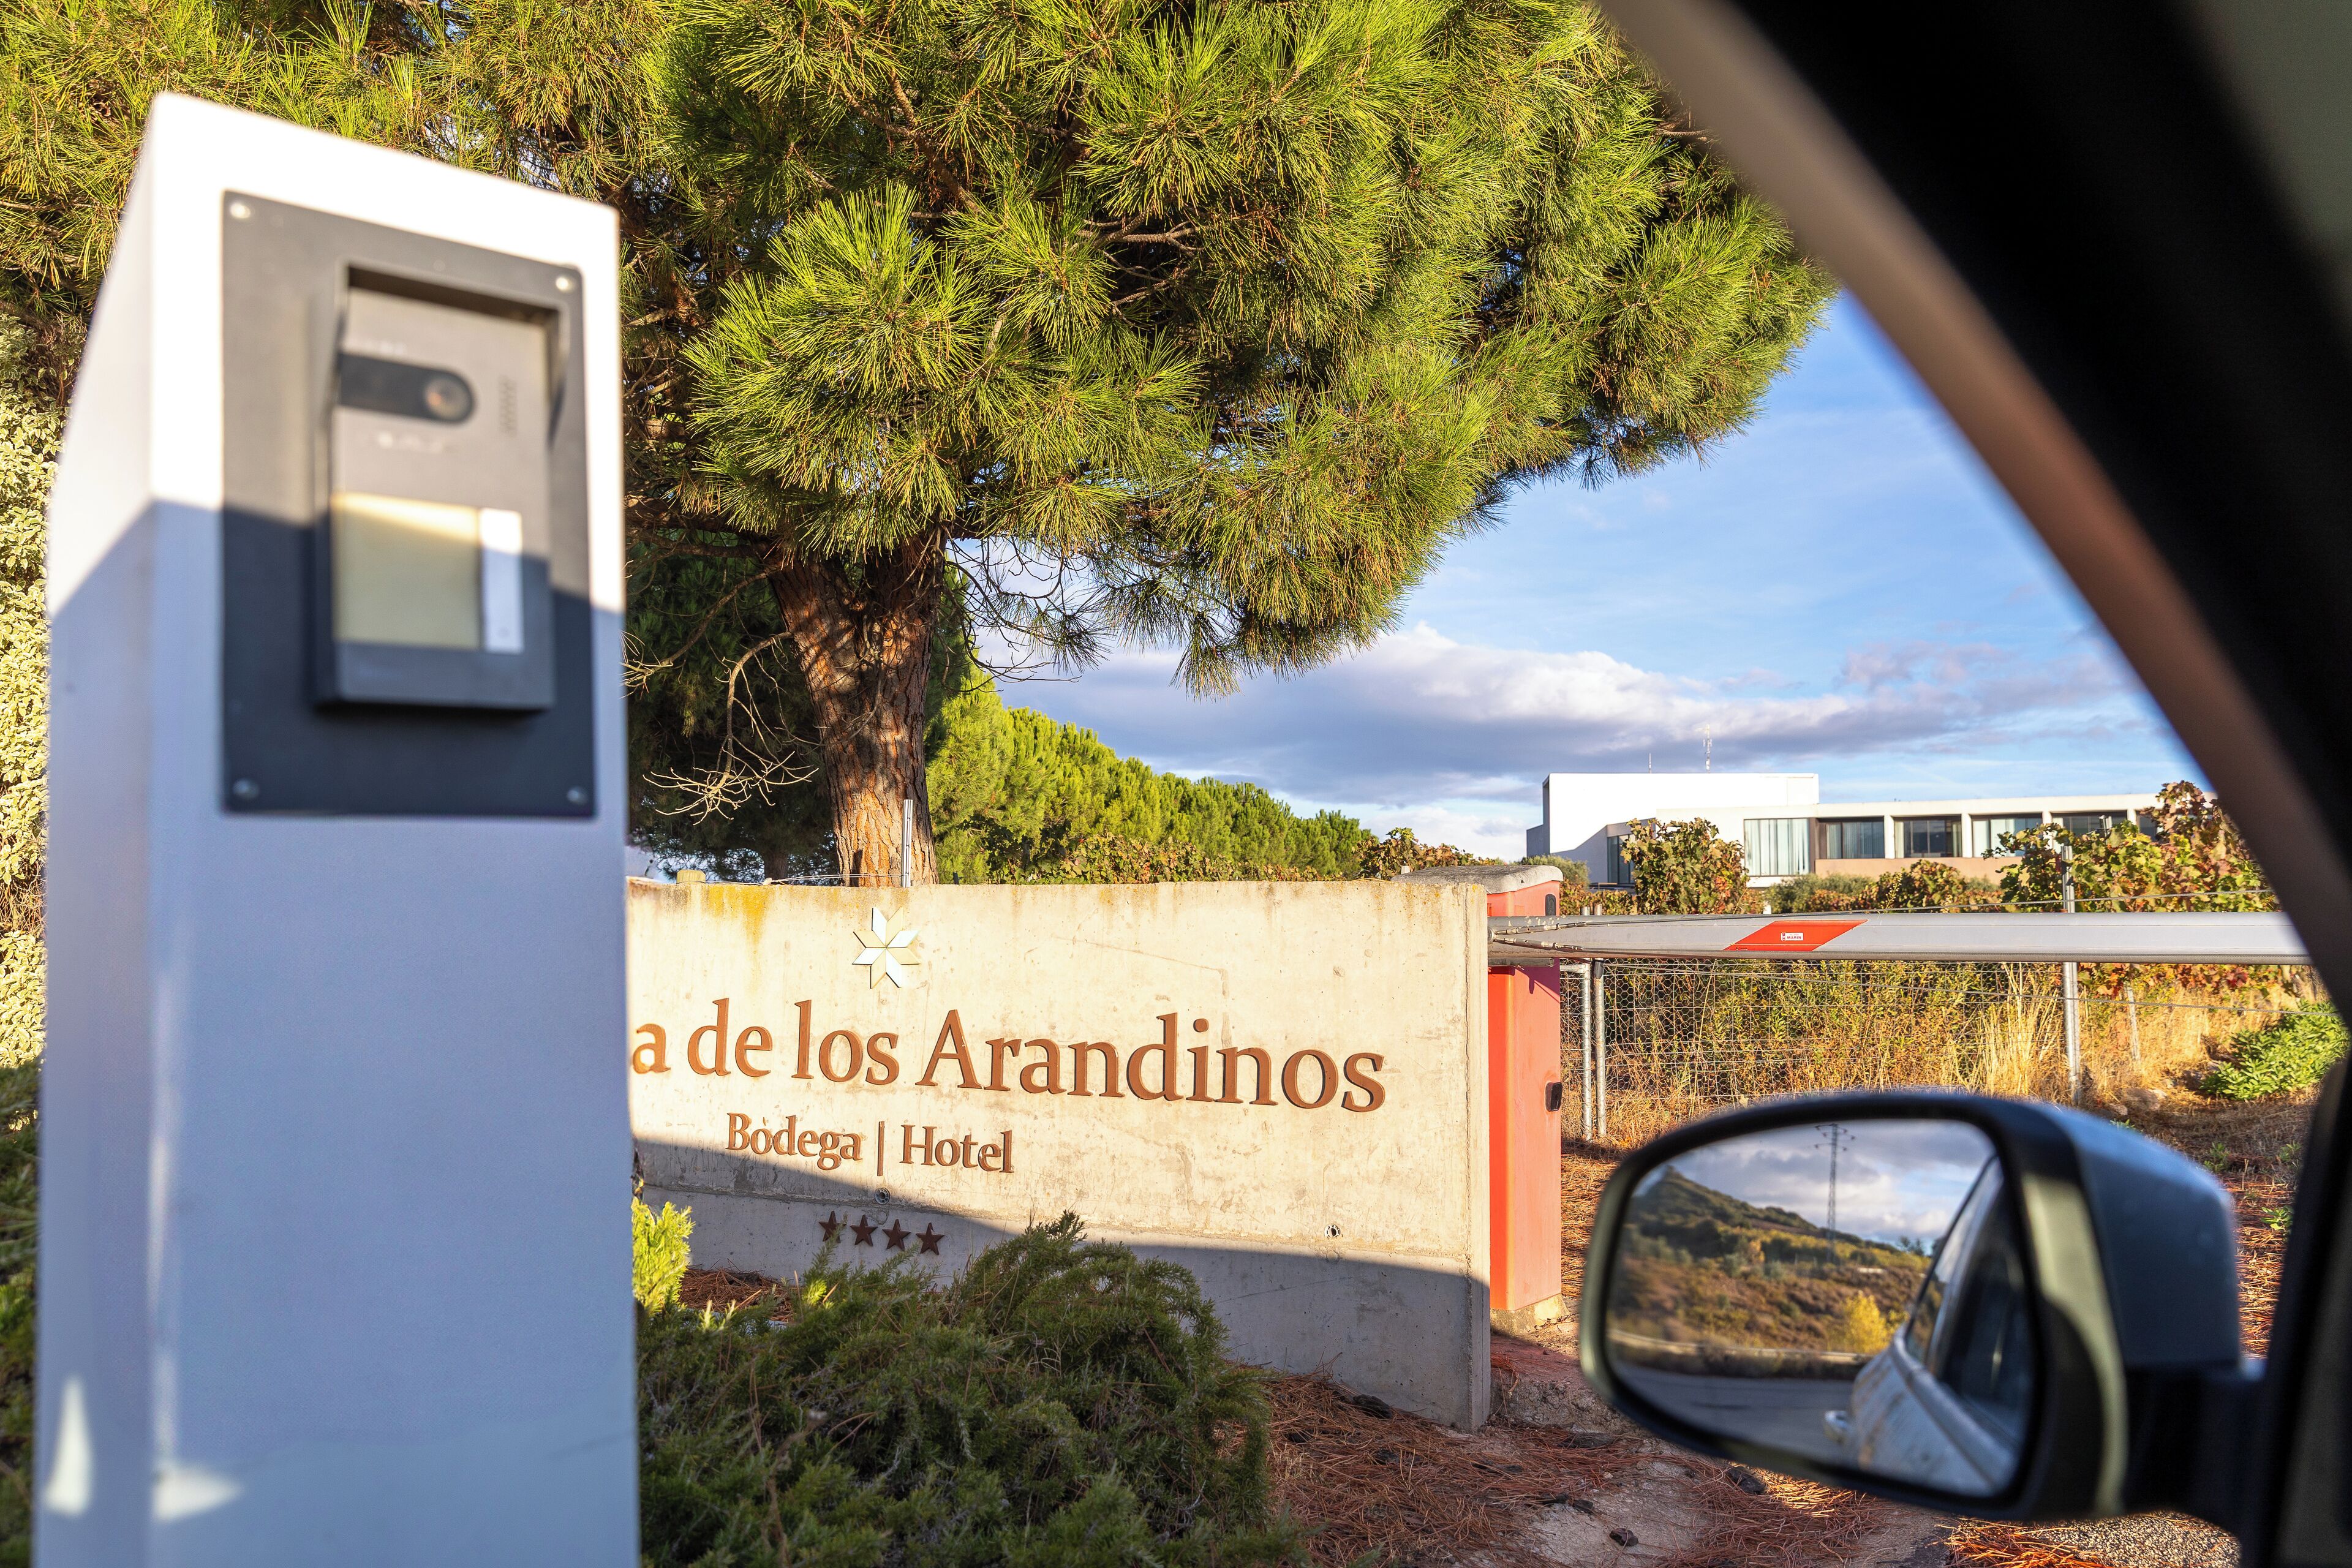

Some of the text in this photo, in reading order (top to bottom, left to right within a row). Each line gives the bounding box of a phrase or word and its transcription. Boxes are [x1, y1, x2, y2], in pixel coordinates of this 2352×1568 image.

[687, 998, 773, 1078] de
[791, 1000, 900, 1085] los
[914, 1009, 1386, 1113] Arandinos
[725, 1112, 1014, 1174] Bodega Hotel
